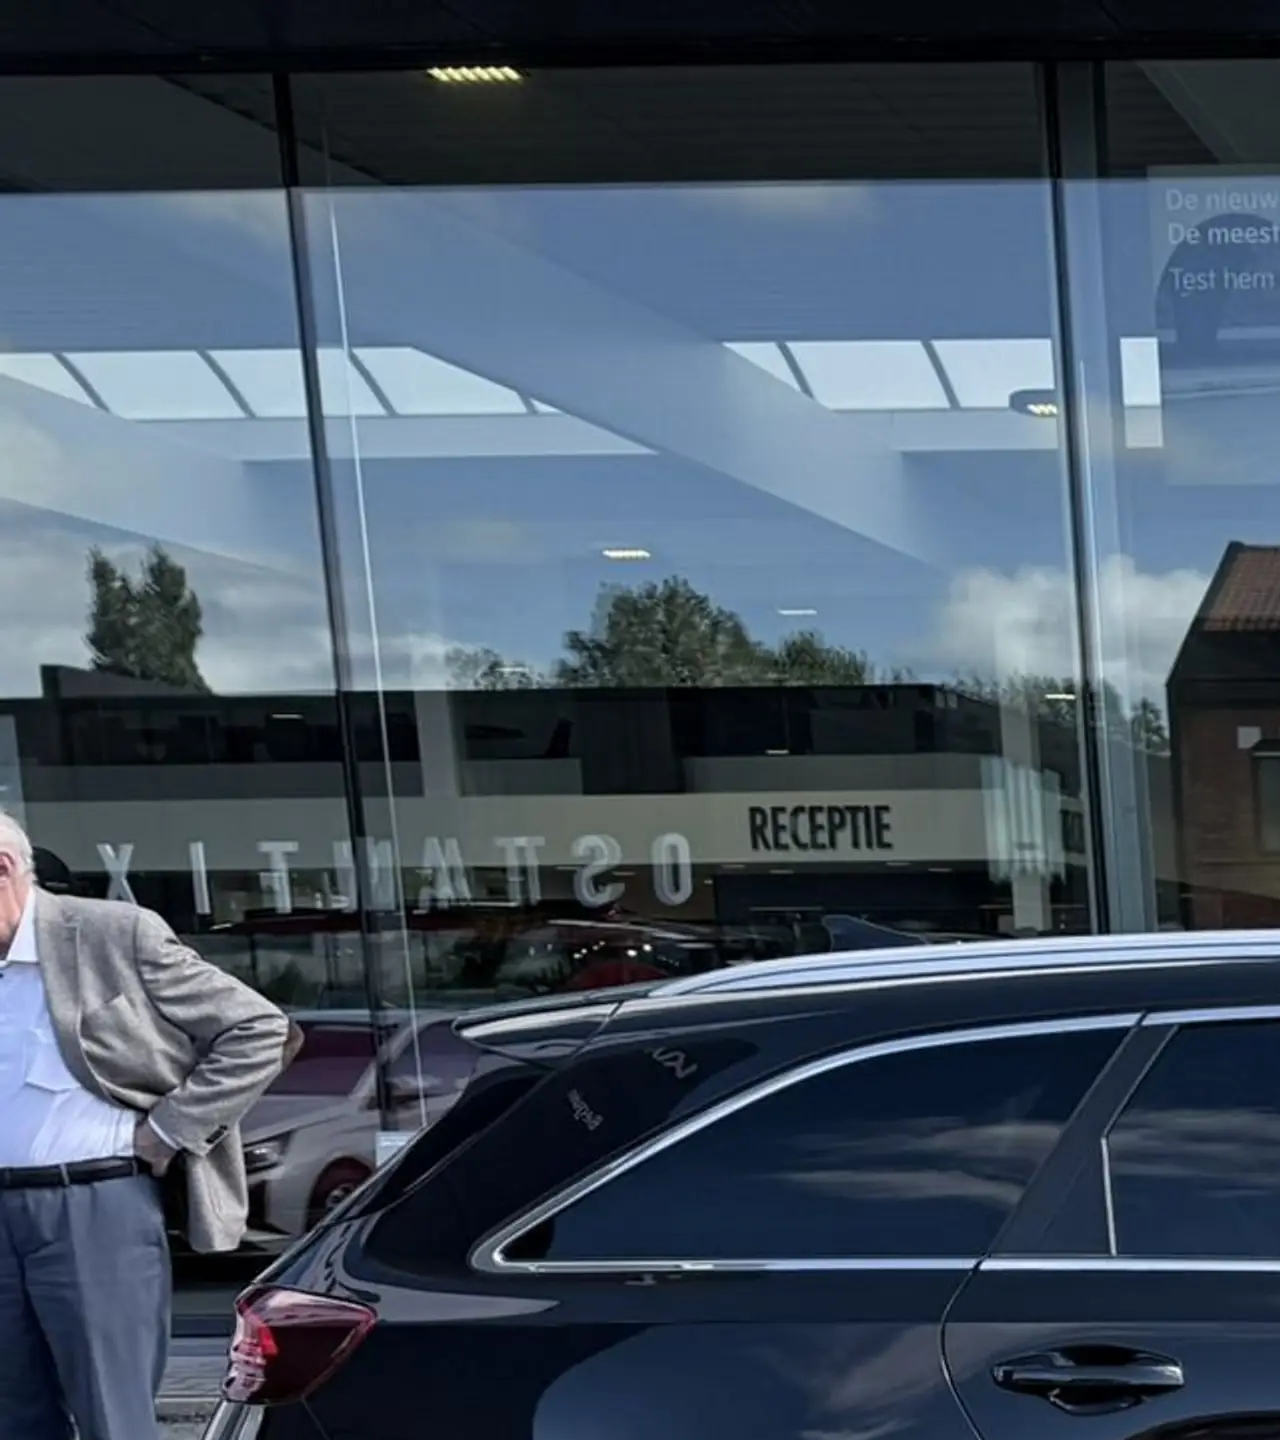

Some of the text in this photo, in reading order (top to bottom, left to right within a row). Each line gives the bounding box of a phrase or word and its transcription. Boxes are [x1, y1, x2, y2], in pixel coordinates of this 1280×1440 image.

[1165, 189, 1198, 211] De
[1168, 222, 1201, 244] De
[1207, 224, 1280, 245] meest
[1168, 267, 1217, 291] Test
[1223, 266, 1275, 290] hem
[748, 805, 894, 851] RECEPTIE
